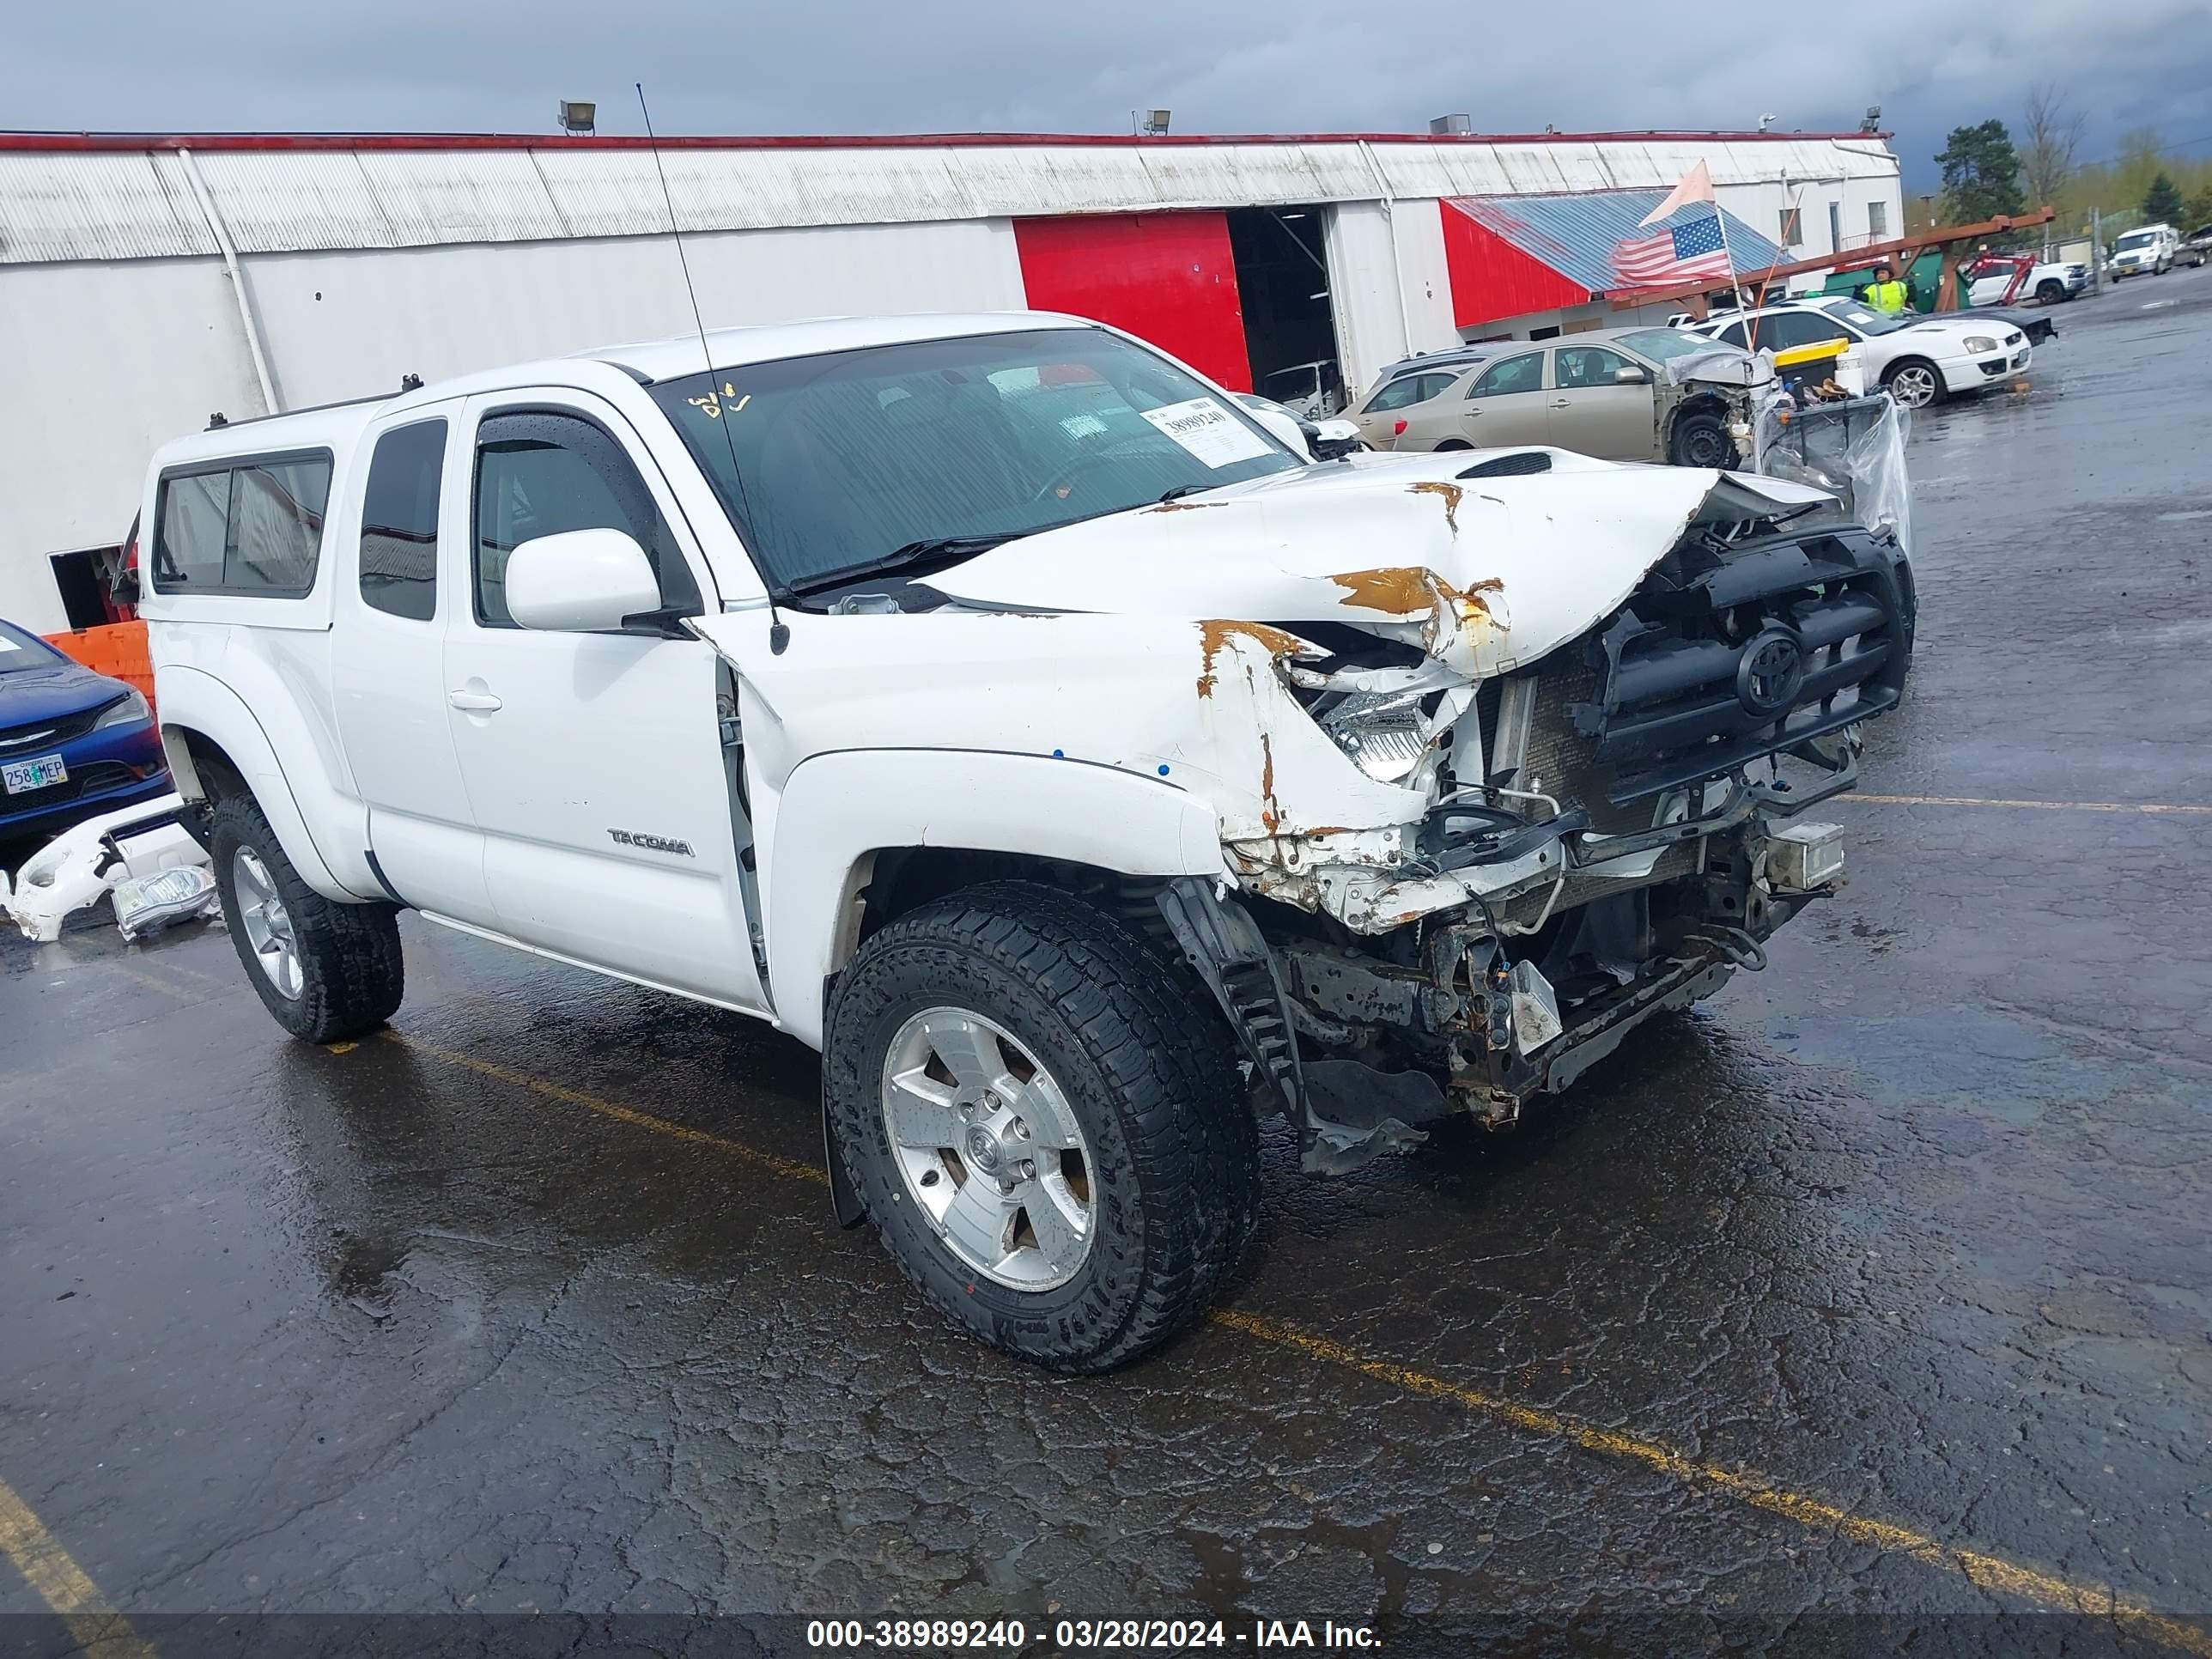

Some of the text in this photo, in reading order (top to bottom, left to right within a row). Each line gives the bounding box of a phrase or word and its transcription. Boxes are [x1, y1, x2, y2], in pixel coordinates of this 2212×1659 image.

[1164, 410, 1226, 434] 38989240
[6, 761, 63, 787] 258 MEP
[606, 827, 696, 858] TACOMA
